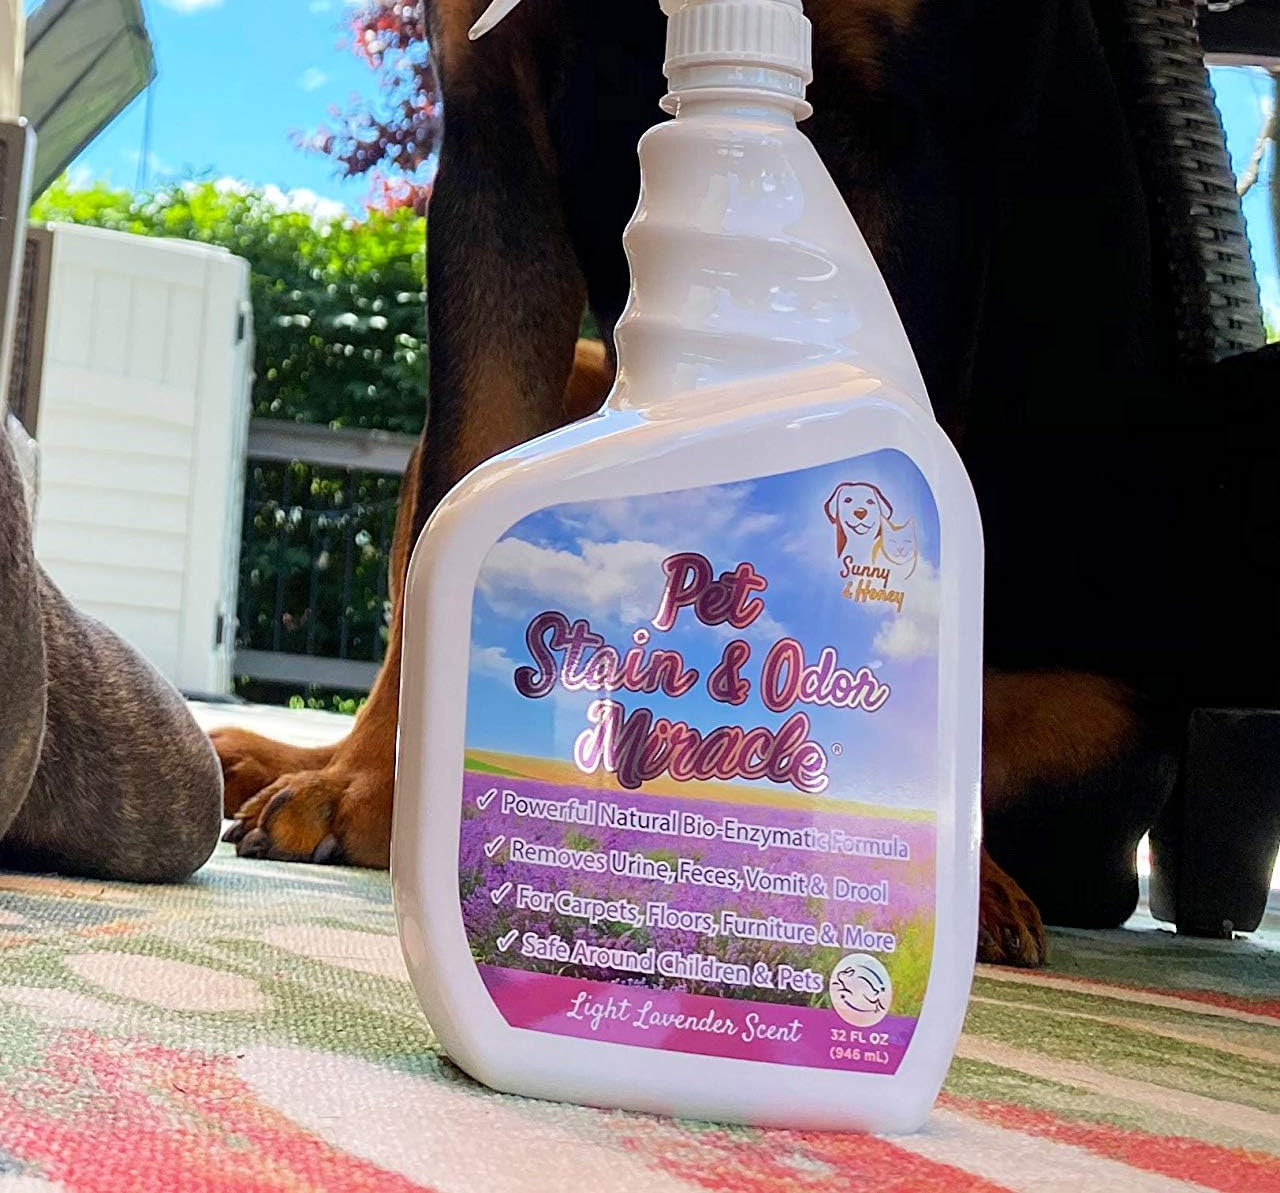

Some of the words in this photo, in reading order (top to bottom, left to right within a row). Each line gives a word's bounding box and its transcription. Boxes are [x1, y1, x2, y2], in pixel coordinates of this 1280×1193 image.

[651, 552, 768, 632] Pet
[840, 555, 890, 589] Sunny
[854, 578, 904, 614] Honey
[514, 611, 699, 699] Stain
[707, 639, 751, 706] &
[760, 637, 891, 712] Odor
[574, 699, 830, 791] Miracle
[502, 791, 595, 824] Powerful
[600, 804, 678, 834] Natural
[682, 814, 829, 850] Bio-Enzymatic
[831, 831, 909, 859] Formula
[511, 840, 606, 871] Removes
[611, 850, 675, 883] Urine,
[678, 861, 742, 892] Feces,
[745, 866, 806, 895] Vomit
[810, 876, 826, 896] &
[834, 877, 888, 904] Drool
[517, 884, 552, 910] For
[555, 892, 644, 927] Carpets,
[647, 903, 718, 932] Floors,
[722, 912, 816, 943] Furniture
[820, 924, 837, 946] &
[845, 926, 895, 951] More
[522, 933, 570, 959] Safe
[573, 940, 655, 973] Around
[658, 951, 751, 984] Children
[754, 963, 771, 987] &
[778, 966, 823, 991] Pets
[566, 992, 631, 1031] Light
[633, 1001, 738, 1036] Lavender
[741, 1013, 804, 1043] Scent
[830, 1028, 847, 1041] 32
[850, 1030, 867, 1044] FL
[869, 1032, 889, 1046] OZ
[829, 1046, 861, 1060] (946
[864, 1050, 889, 1064] mL)
